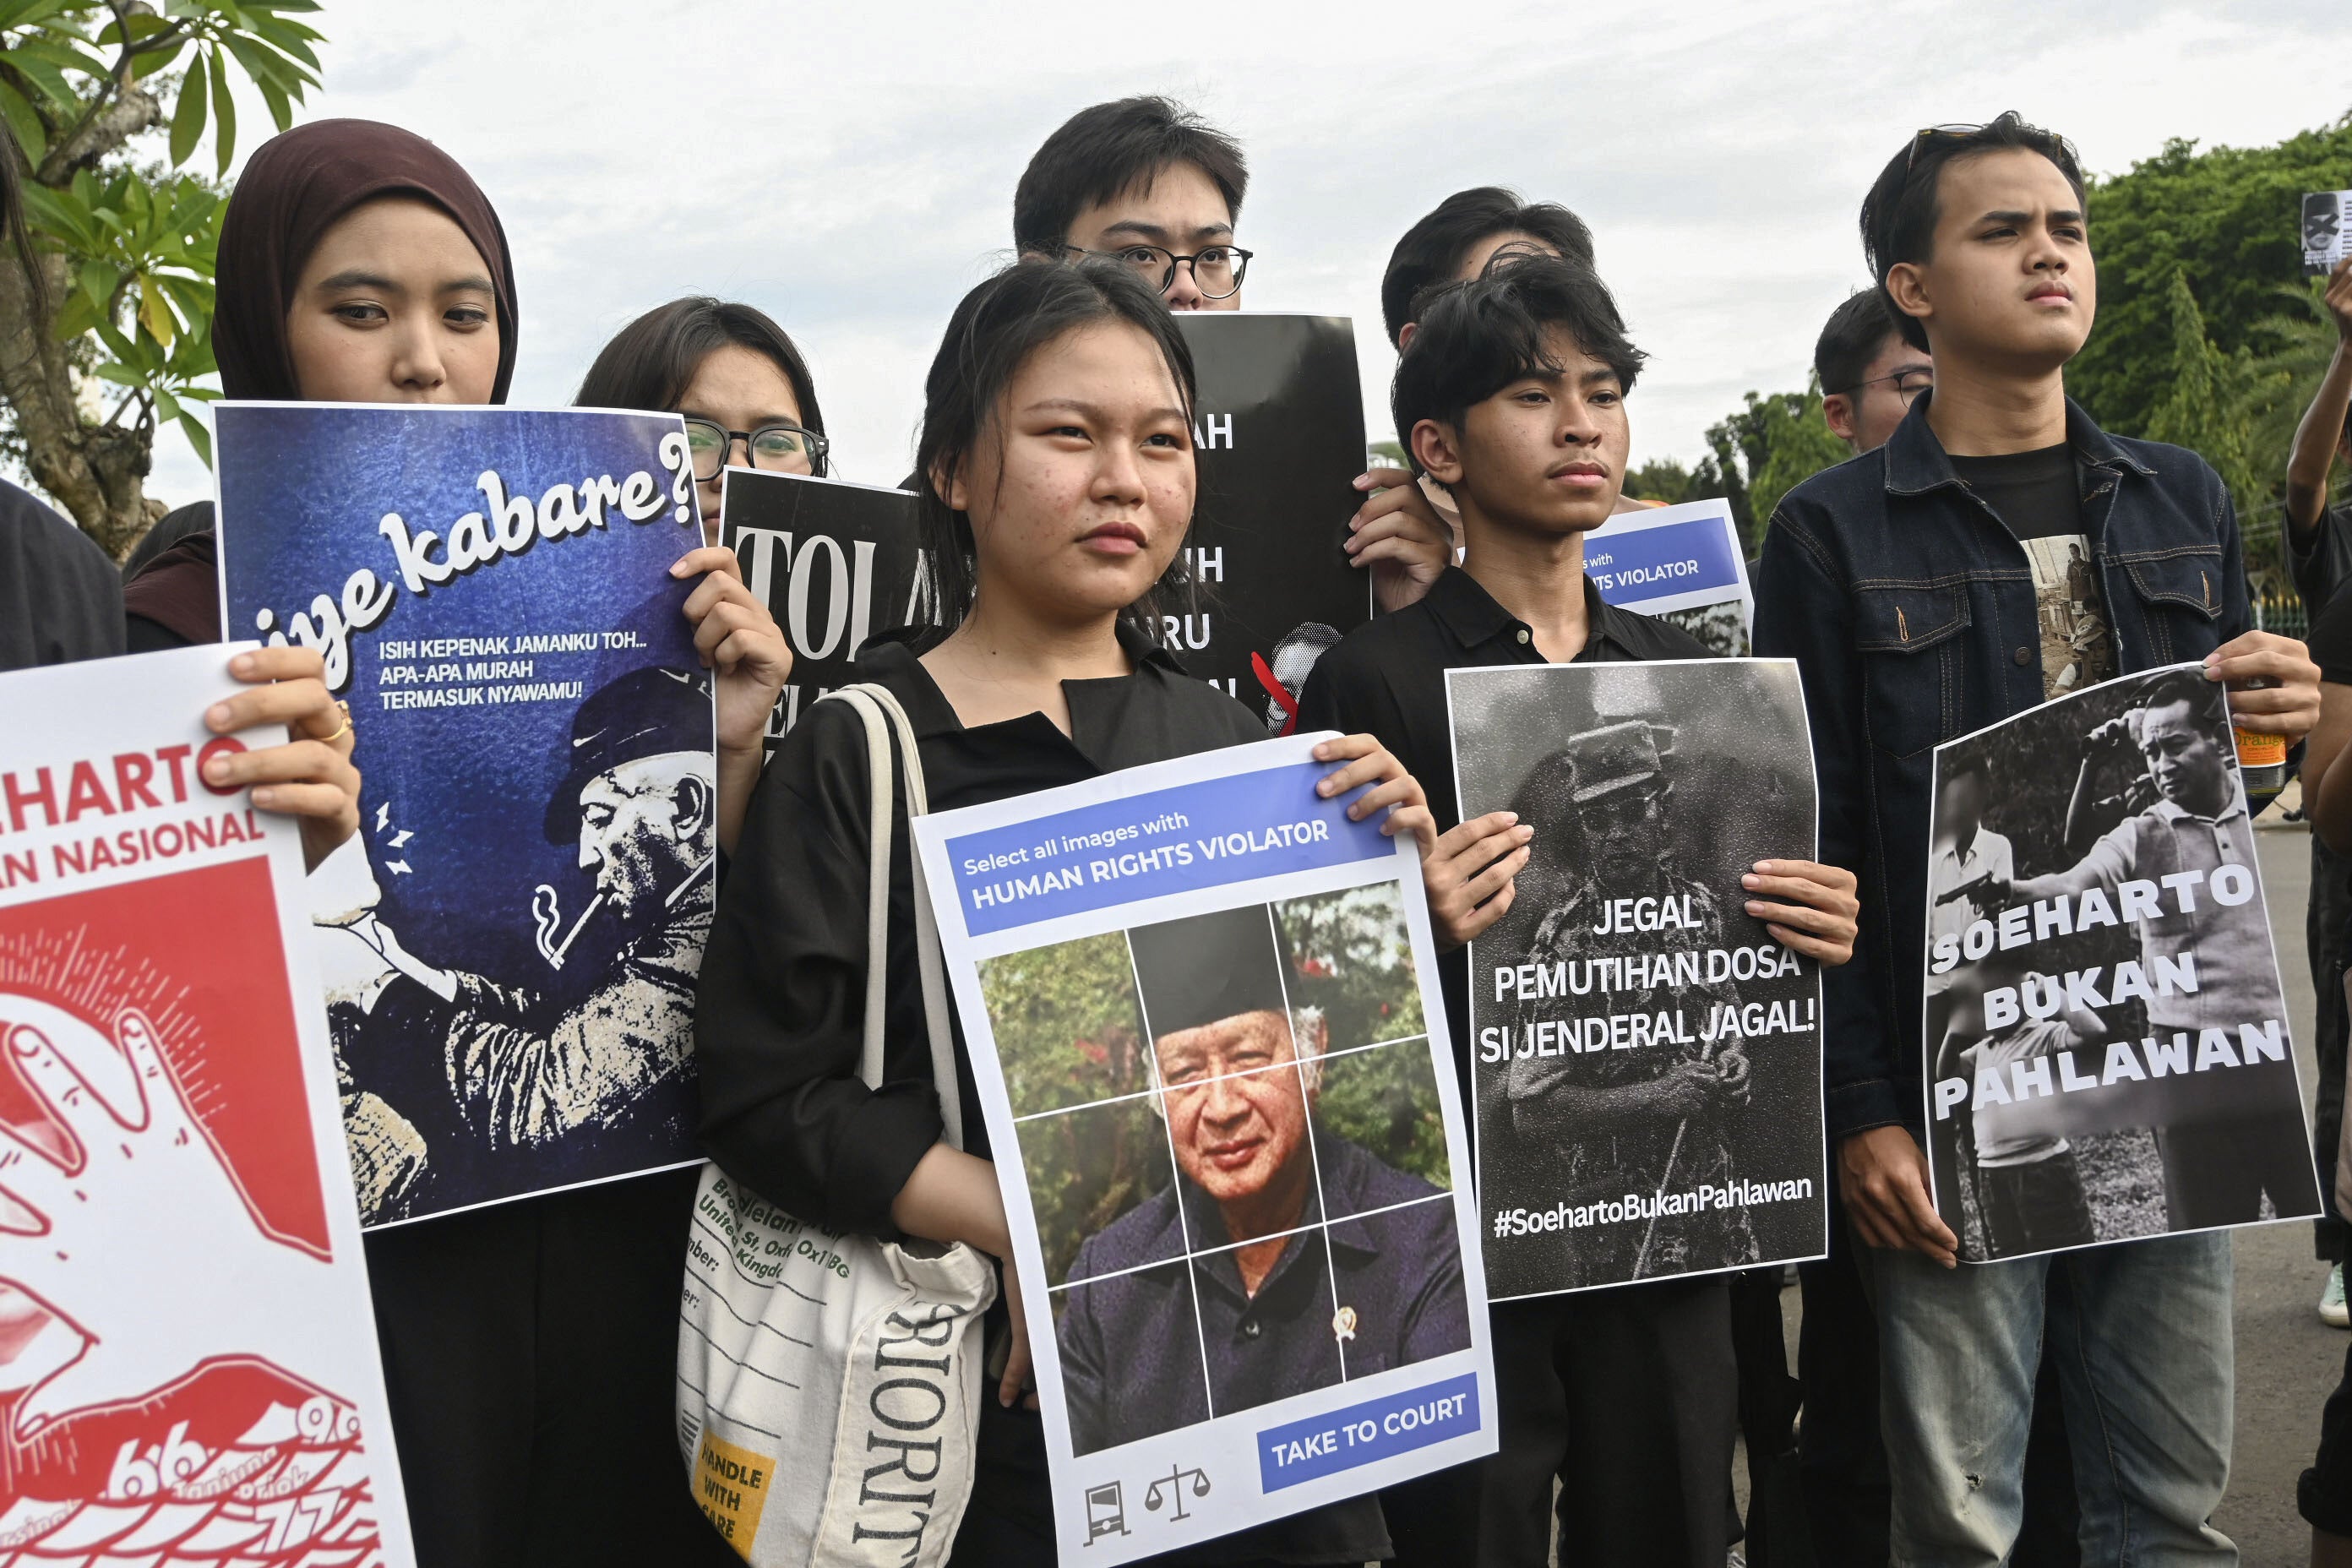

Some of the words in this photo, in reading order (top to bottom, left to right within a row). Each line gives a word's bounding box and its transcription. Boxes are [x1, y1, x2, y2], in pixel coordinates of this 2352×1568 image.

[378, 432, 693, 592] kabare?
[1589, 553, 1613, 567] with
[1616, 559, 1699, 586] VIOLATOR
[379, 640, 416, 660] ISIH
[420, 638, 509, 659] KEPENAK
[512, 634, 598, 654] JAMANKU
[602, 630, 647, 651] TOH...
[379, 662, 465, 686] APA-APA
[466, 660, 534, 682] MURAH
[380, 686, 485, 710] TERMASUK
[487, 681, 583, 704] NYAWAMU!
[0, 736, 250, 832] HARTO
[52, 808, 265, 878] NASIONAL
[963, 847, 1030, 876] Select
[1032, 838, 1059, 858] all
[1061, 824, 1140, 854] images
[1141, 811, 1190, 836] with
[971, 864, 1085, 910] HUMAN
[1091, 841, 1195, 884] RIGHTS
[1196, 818, 1330, 861] VIOLATOR
[1592, 894, 1702, 935] JEGAL
[1931, 863, 2255, 974] SOEHARTO
[1494, 952, 1700, 1003] PEMUTIHAN
[1707, 945, 1802, 984] DOSA
[1983, 951, 2199, 1031] BUKAN
[1479, 1025, 1511, 1063] SI
[1515, 1010, 1696, 1060] JENDERAL
[1699, 997, 1816, 1042] JAGAL!
[1934, 1019, 2286, 1121] PAHLAWAN
[738, 1195, 798, 1234] dleian
[1494, 1177, 1812, 1239] #SoehartoBukanPahlawan
[1271, 1429, 1339, 1468] TAKE
[1342, 1418, 1378, 1448] TO
[1382, 1392, 1467, 1436] COURT
[702, 1442, 763, 1489] HANDLE
[705, 1473, 742, 1511] WITH
